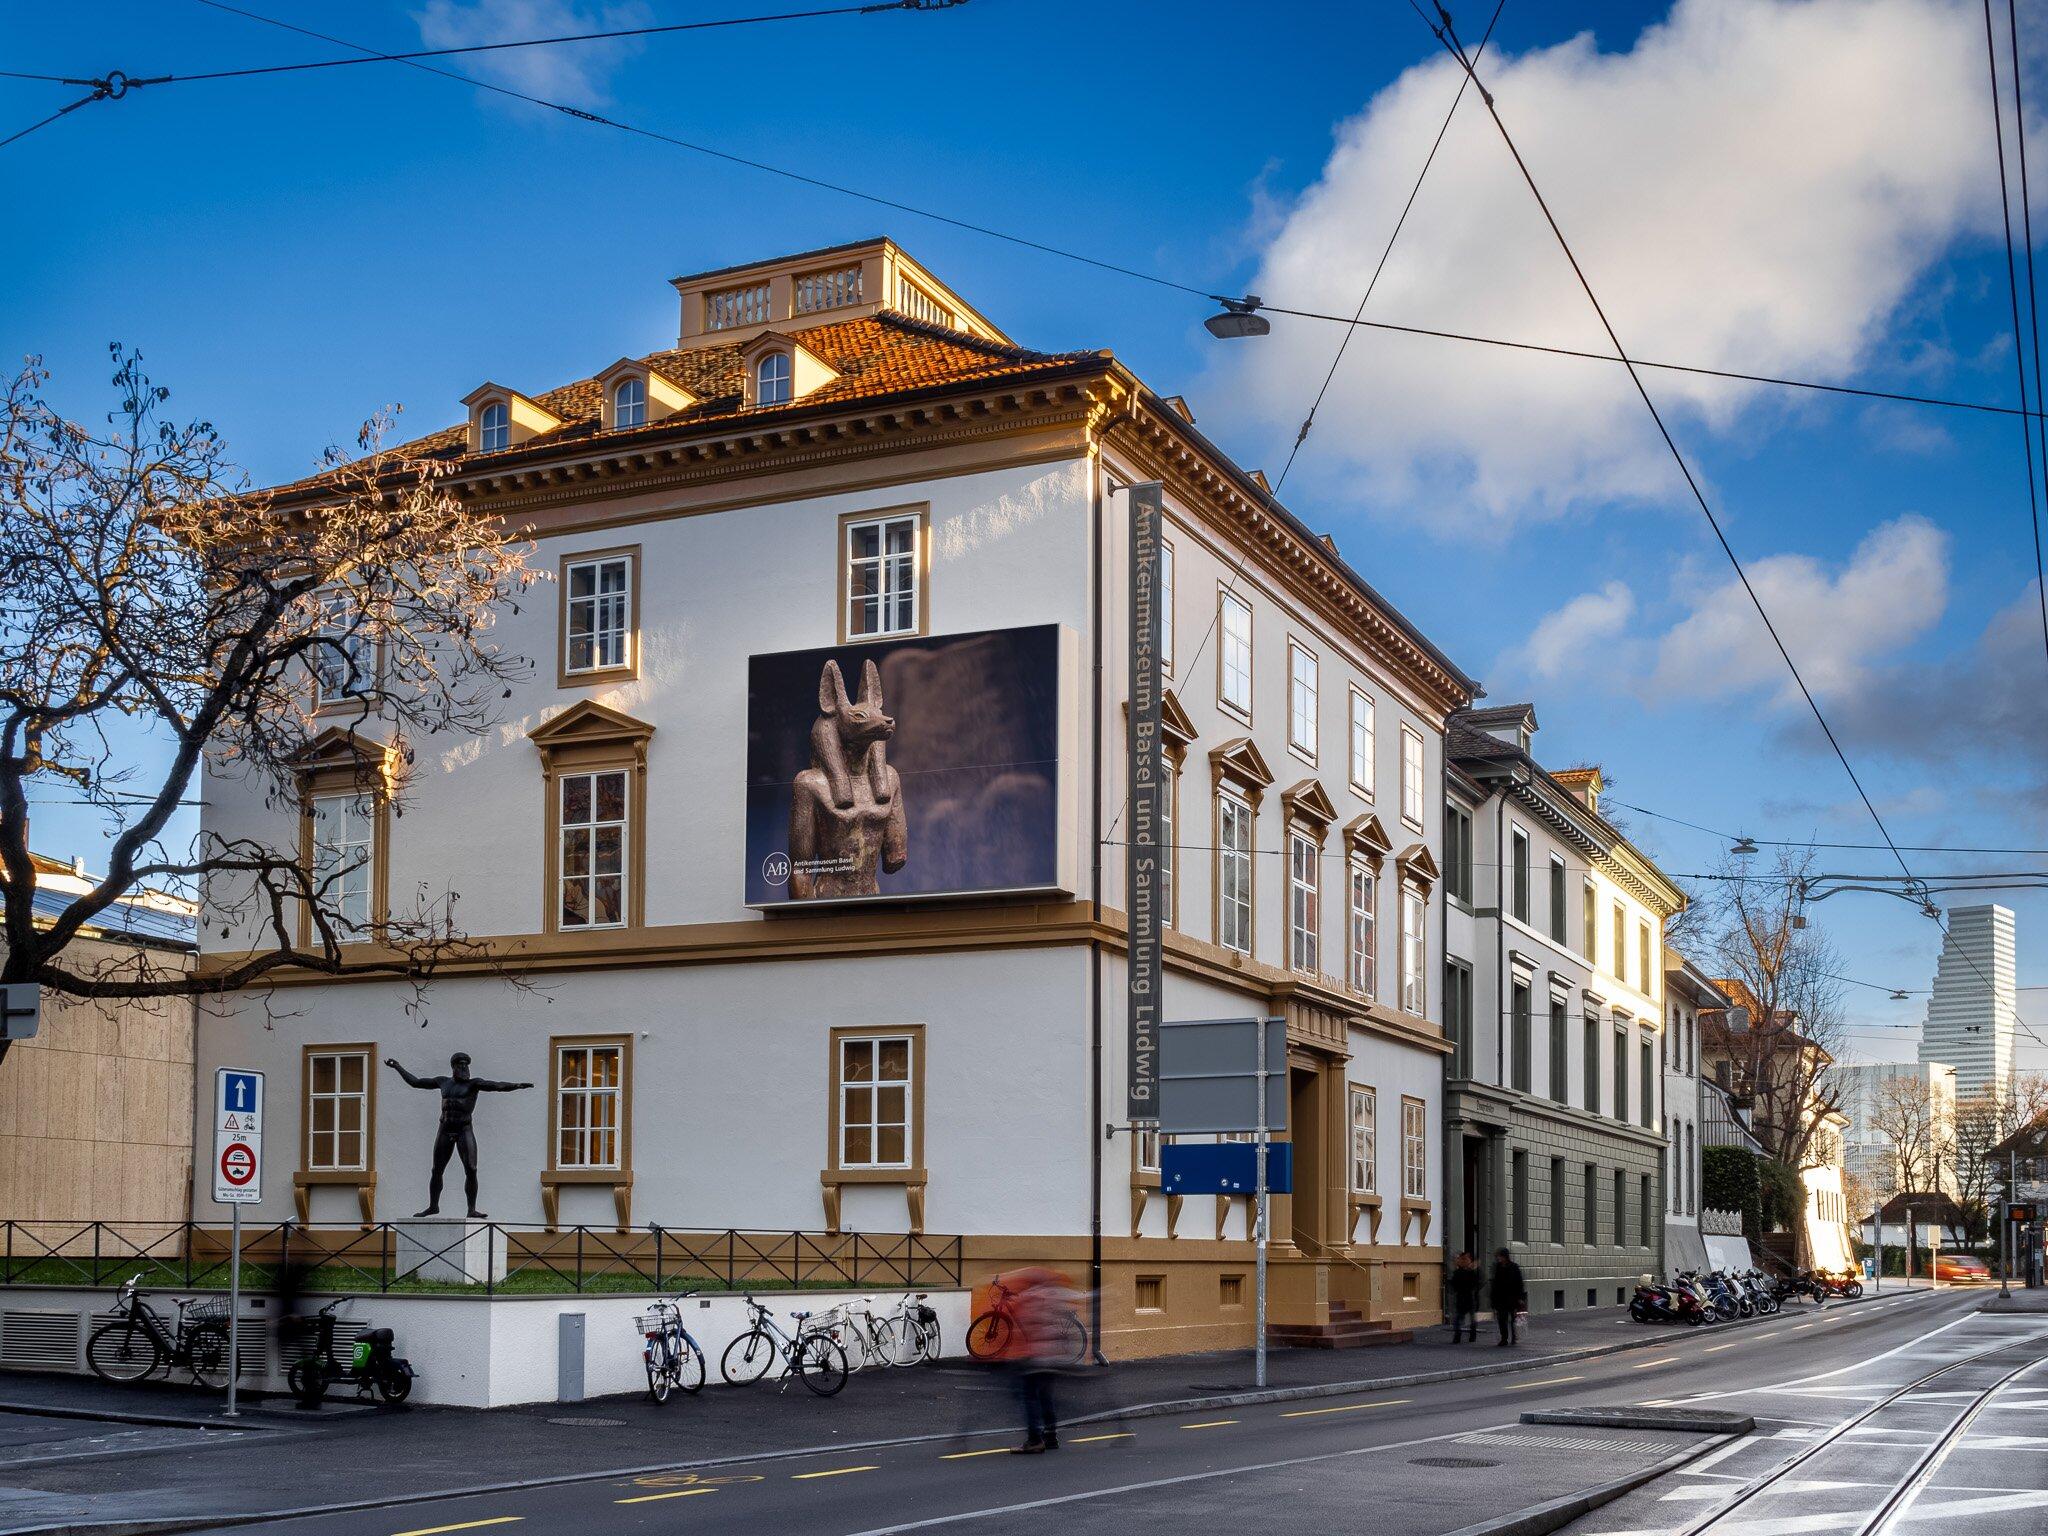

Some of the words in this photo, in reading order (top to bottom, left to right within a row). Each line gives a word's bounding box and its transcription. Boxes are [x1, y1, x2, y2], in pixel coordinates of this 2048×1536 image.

[1136, 501, 1156, 713] Antikenmuseum
[1136, 722, 1156, 788] Basel
[1136, 799, 1155, 846] und
[793, 859, 838, 867] Antikenmuseum
[805, 866, 834, 874] Sammlung
[1130, 857, 1155, 995] Sammlung
[1130, 1004, 1155, 1101] Ludwig
[232, 1133, 247, 1142] 25m
